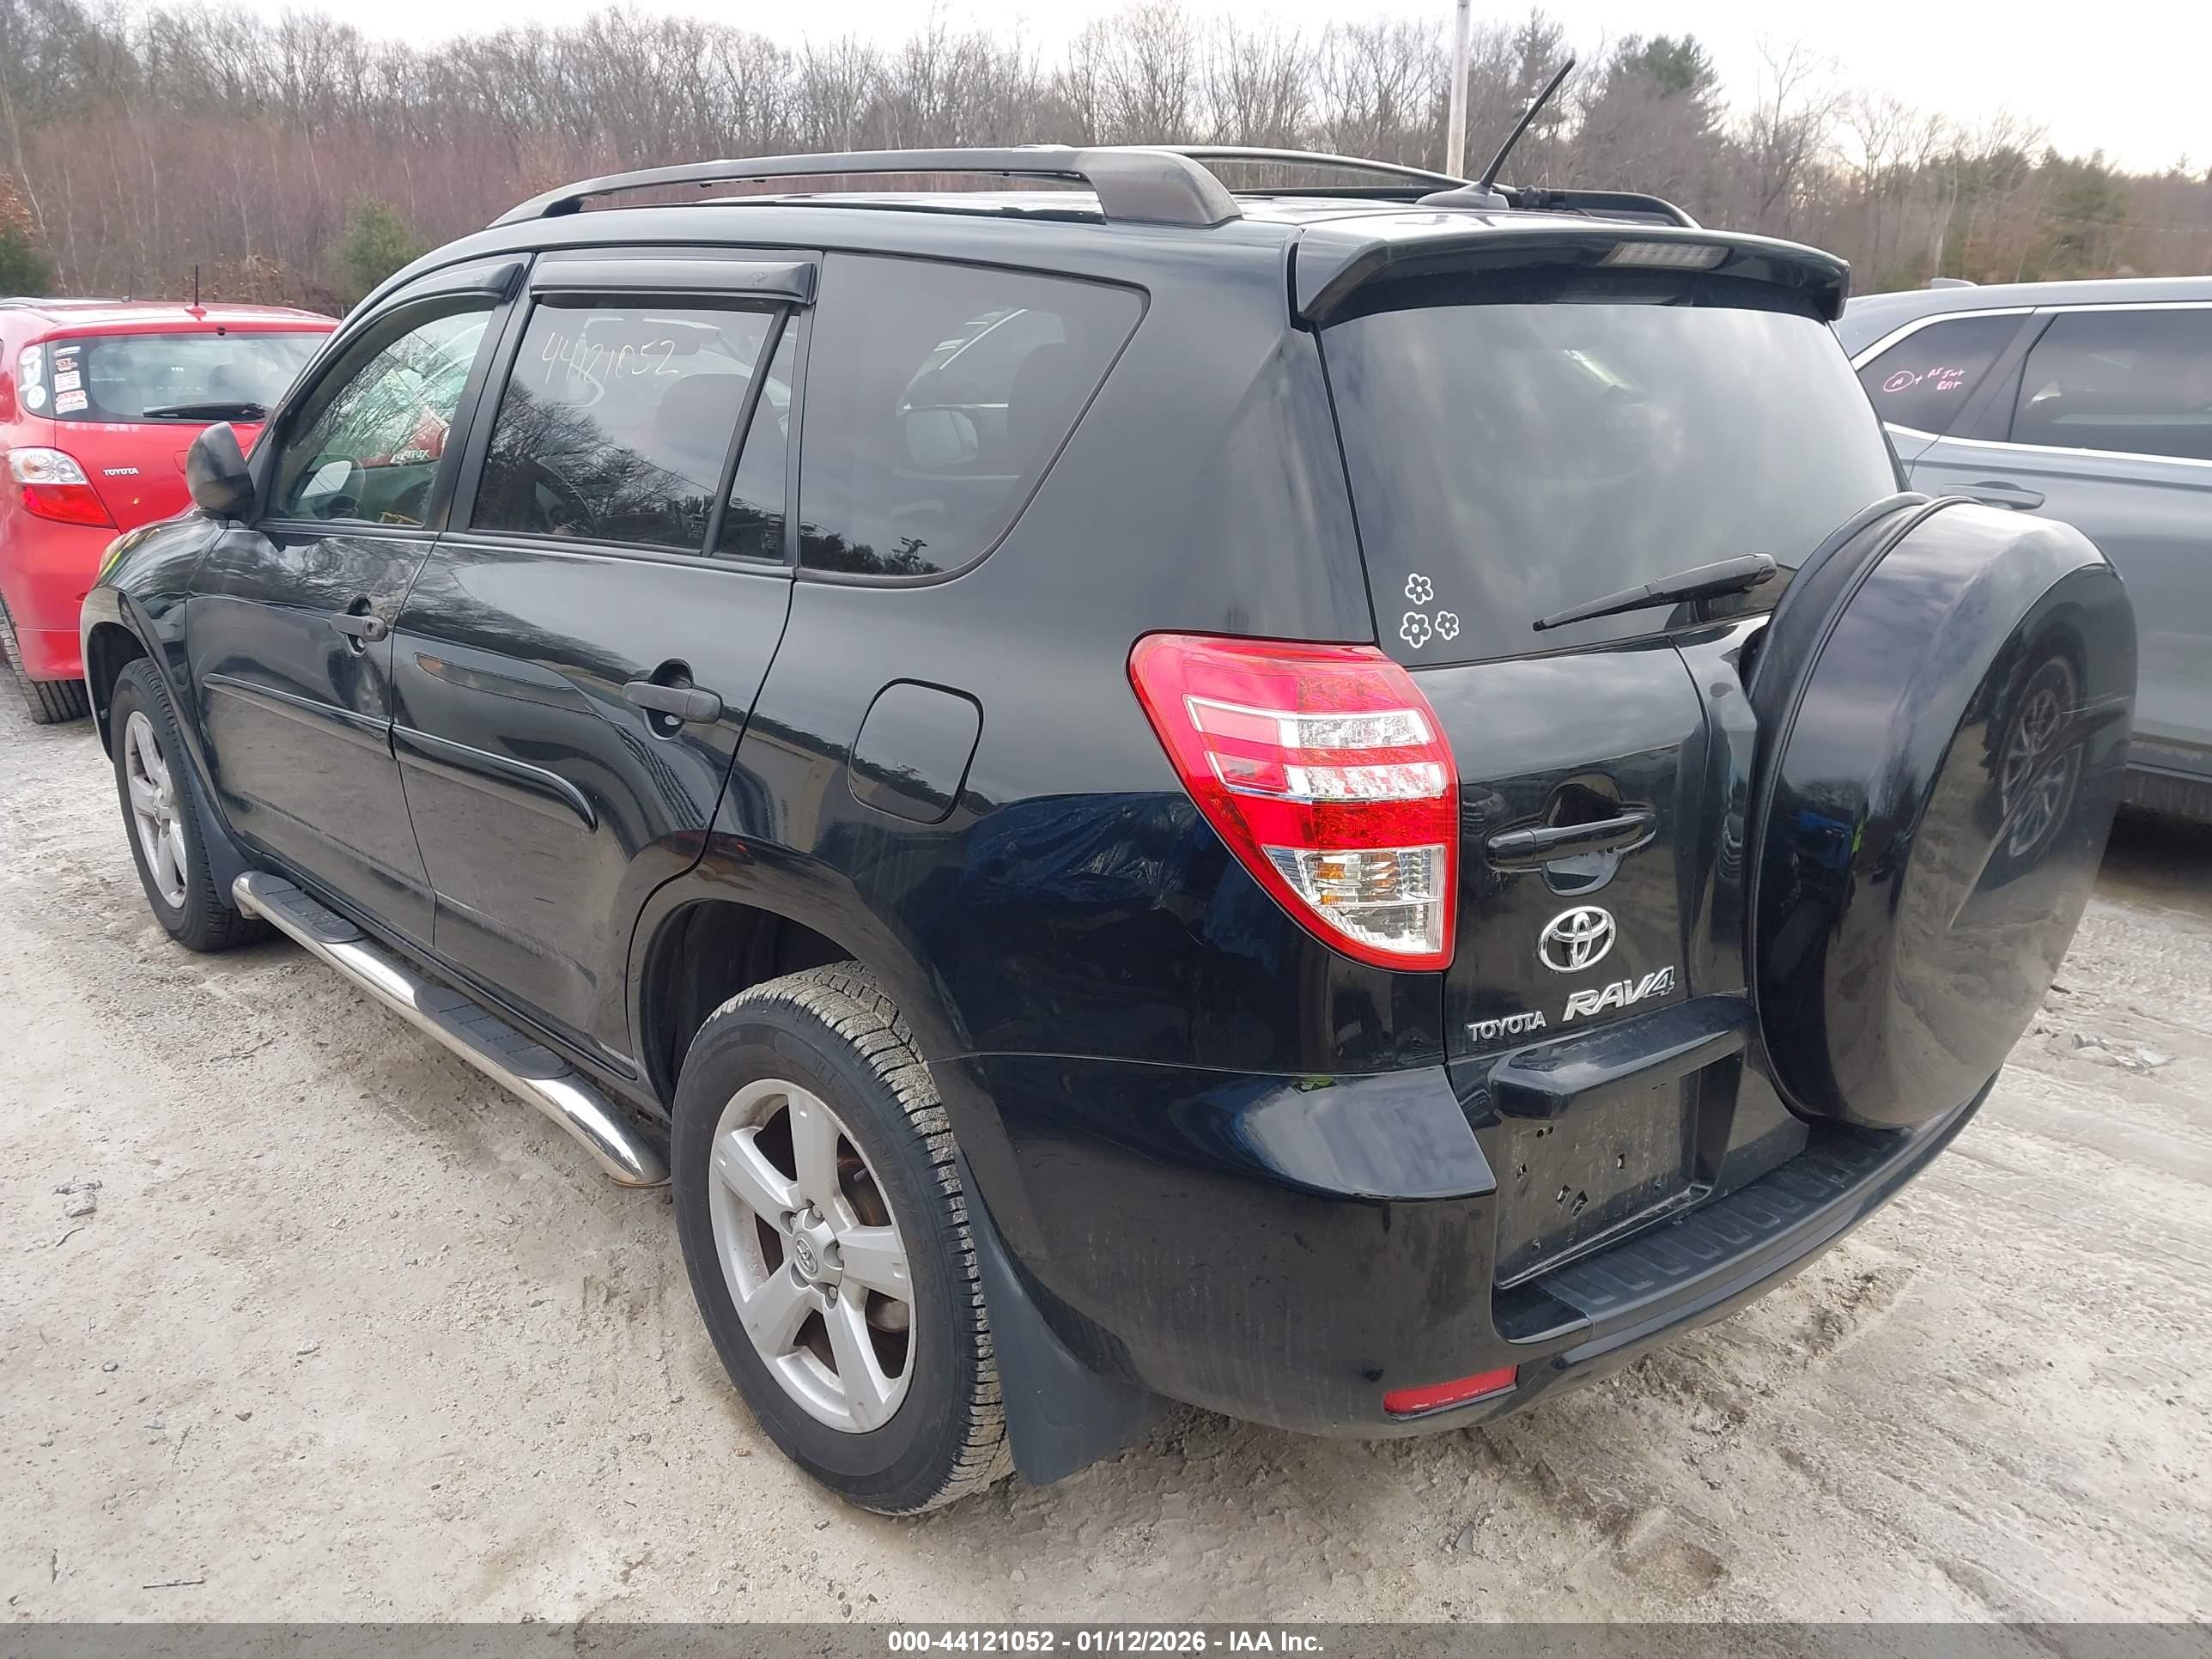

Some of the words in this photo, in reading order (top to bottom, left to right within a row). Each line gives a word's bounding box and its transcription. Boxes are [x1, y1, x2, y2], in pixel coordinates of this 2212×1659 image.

[102, 467, 139, 477] TOYOTA
[1561, 965, 1676, 1023] RAV4
[1465, 1010, 1547, 1042] TOYOTA
